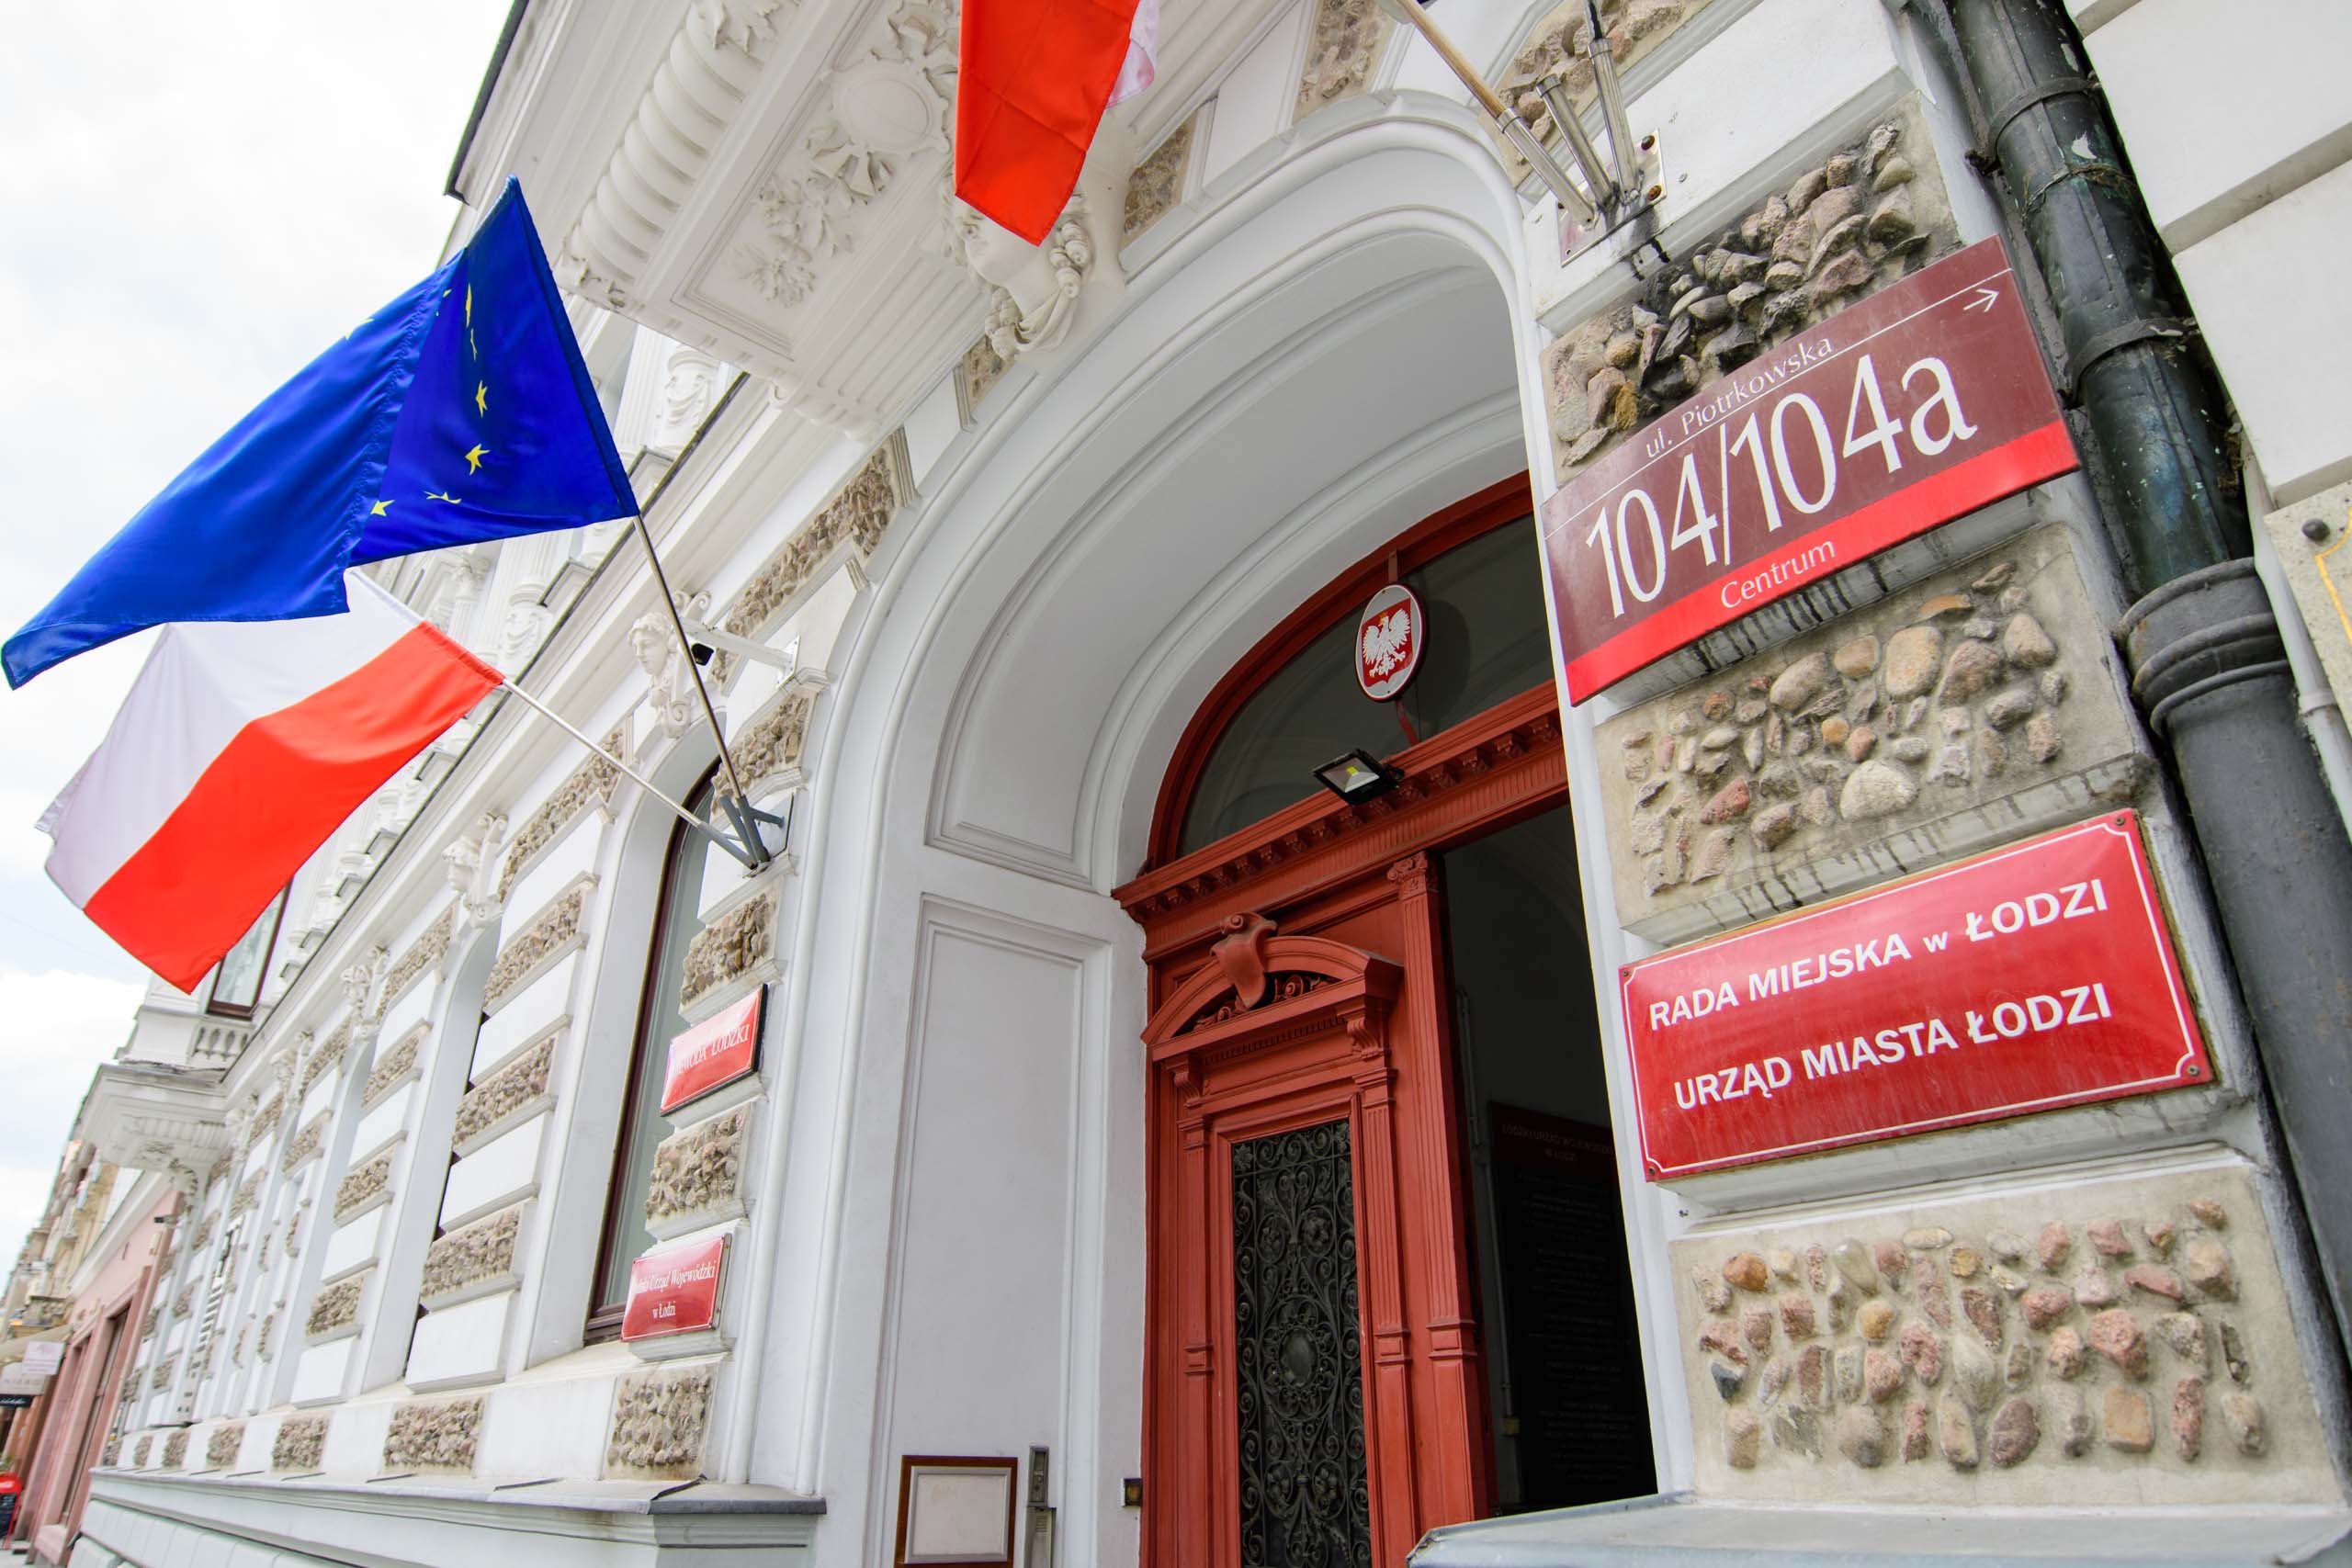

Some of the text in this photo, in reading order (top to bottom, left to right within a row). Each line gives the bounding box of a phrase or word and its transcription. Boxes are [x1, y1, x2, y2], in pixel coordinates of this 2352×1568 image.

[1645, 337, 1834, 458] ul. Piotrkowska
[1586, 354, 1978, 619] 104/104a
[1721, 541, 1837, 609] Centrum
[1648, 877, 2109, 1032] RADA MIEJSKA w ŁODZI
[1673, 983, 2111, 1111] URZĄD MIASTA ŁODZI
